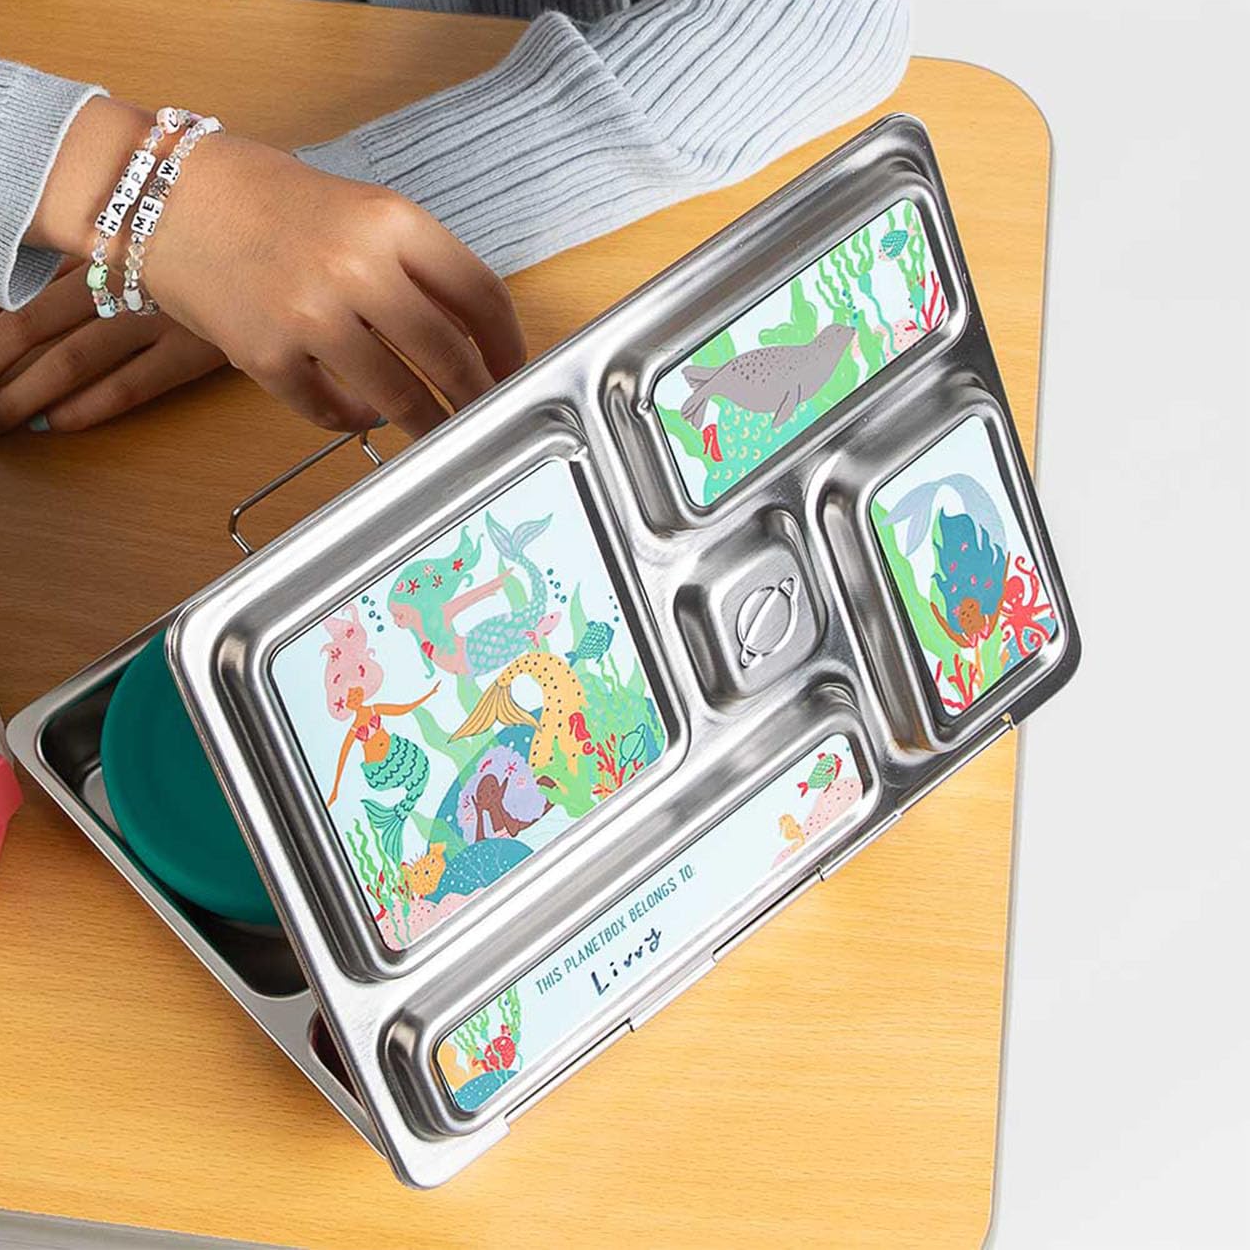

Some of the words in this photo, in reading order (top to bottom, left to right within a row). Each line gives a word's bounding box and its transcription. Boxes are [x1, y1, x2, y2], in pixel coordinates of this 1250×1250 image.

[104, 153, 153, 233] HAPPY
[535, 966, 563, 995] THIS
[563, 916, 627, 973] PLANETBOX
[628, 877, 678, 923] BELONGS
